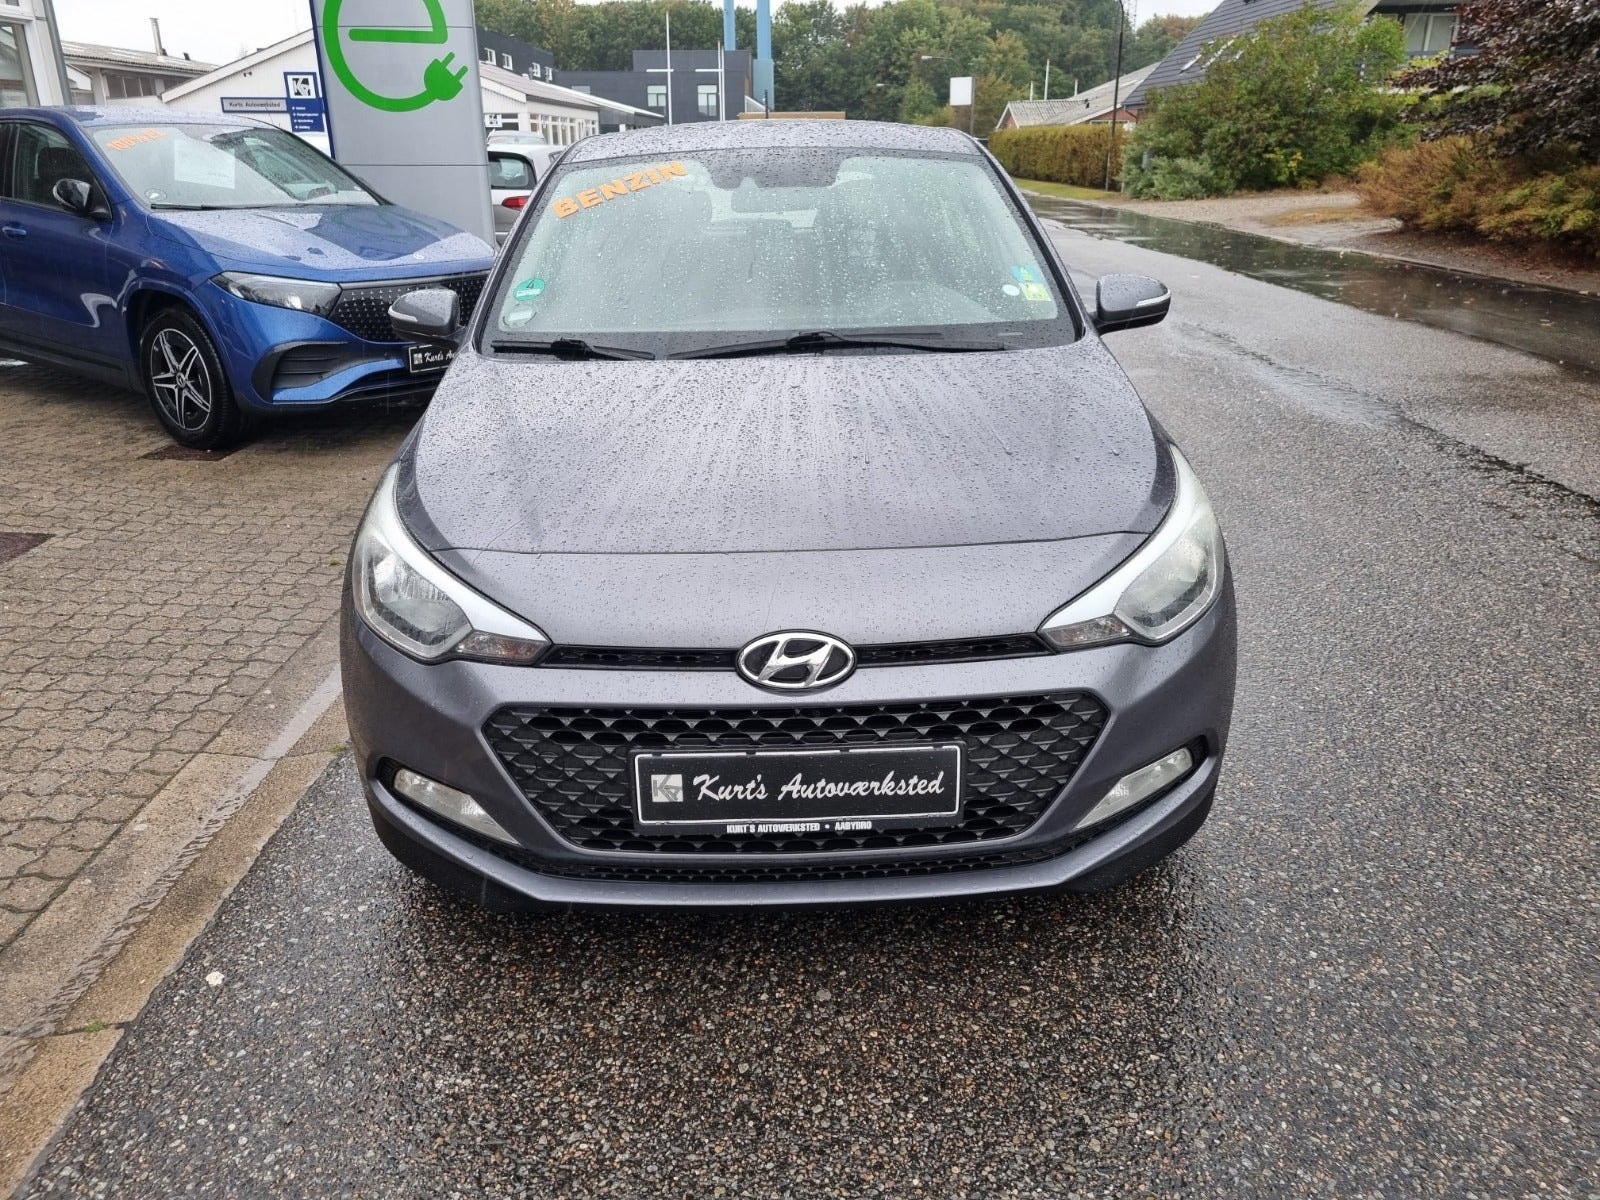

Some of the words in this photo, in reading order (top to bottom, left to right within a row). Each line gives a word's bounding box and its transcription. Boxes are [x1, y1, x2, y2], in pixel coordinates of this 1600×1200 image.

[553, 160, 688, 219] BENZIN
[692, 774, 769, 802] Kurt's
[777, 770, 945, 801] Autoværksted
[834, 820, 872, 831] AABYBRO
